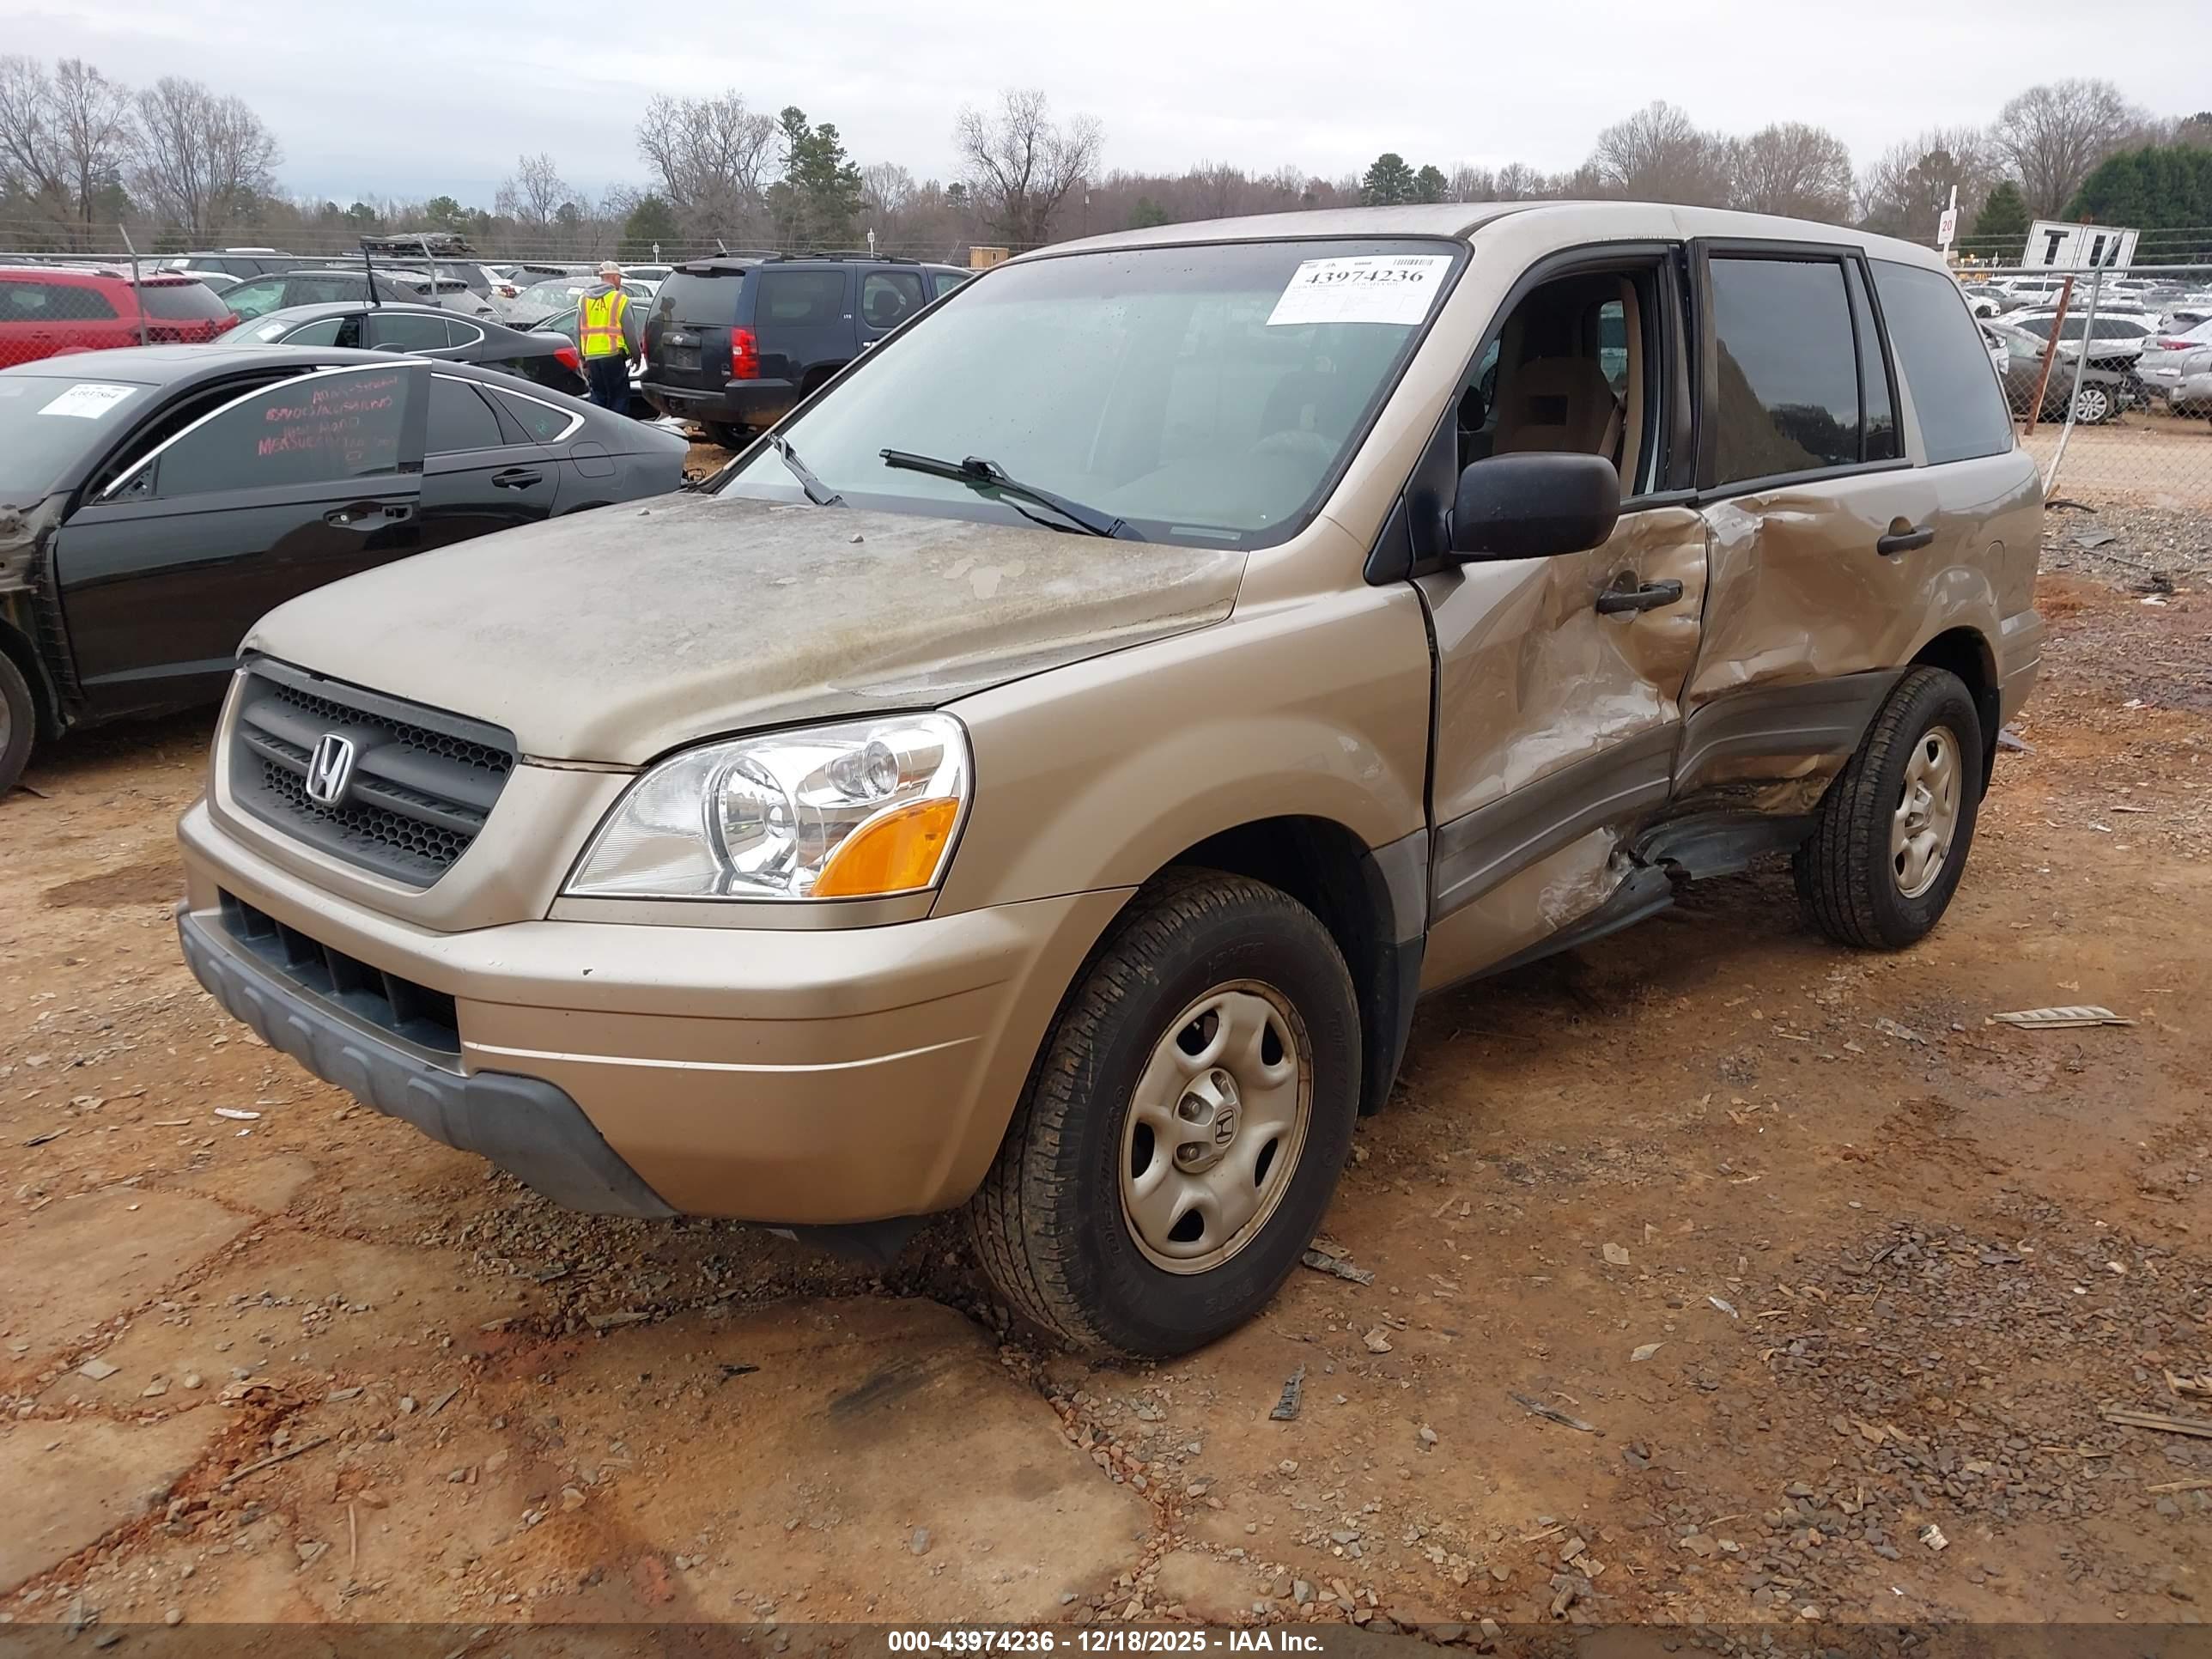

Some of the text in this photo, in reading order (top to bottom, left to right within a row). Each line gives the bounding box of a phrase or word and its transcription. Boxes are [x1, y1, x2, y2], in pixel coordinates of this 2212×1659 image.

[1942, 220, 1953, 232] 20
[2044, 228, 2069, 265] T
[1305, 270, 1426, 284] 43974236
